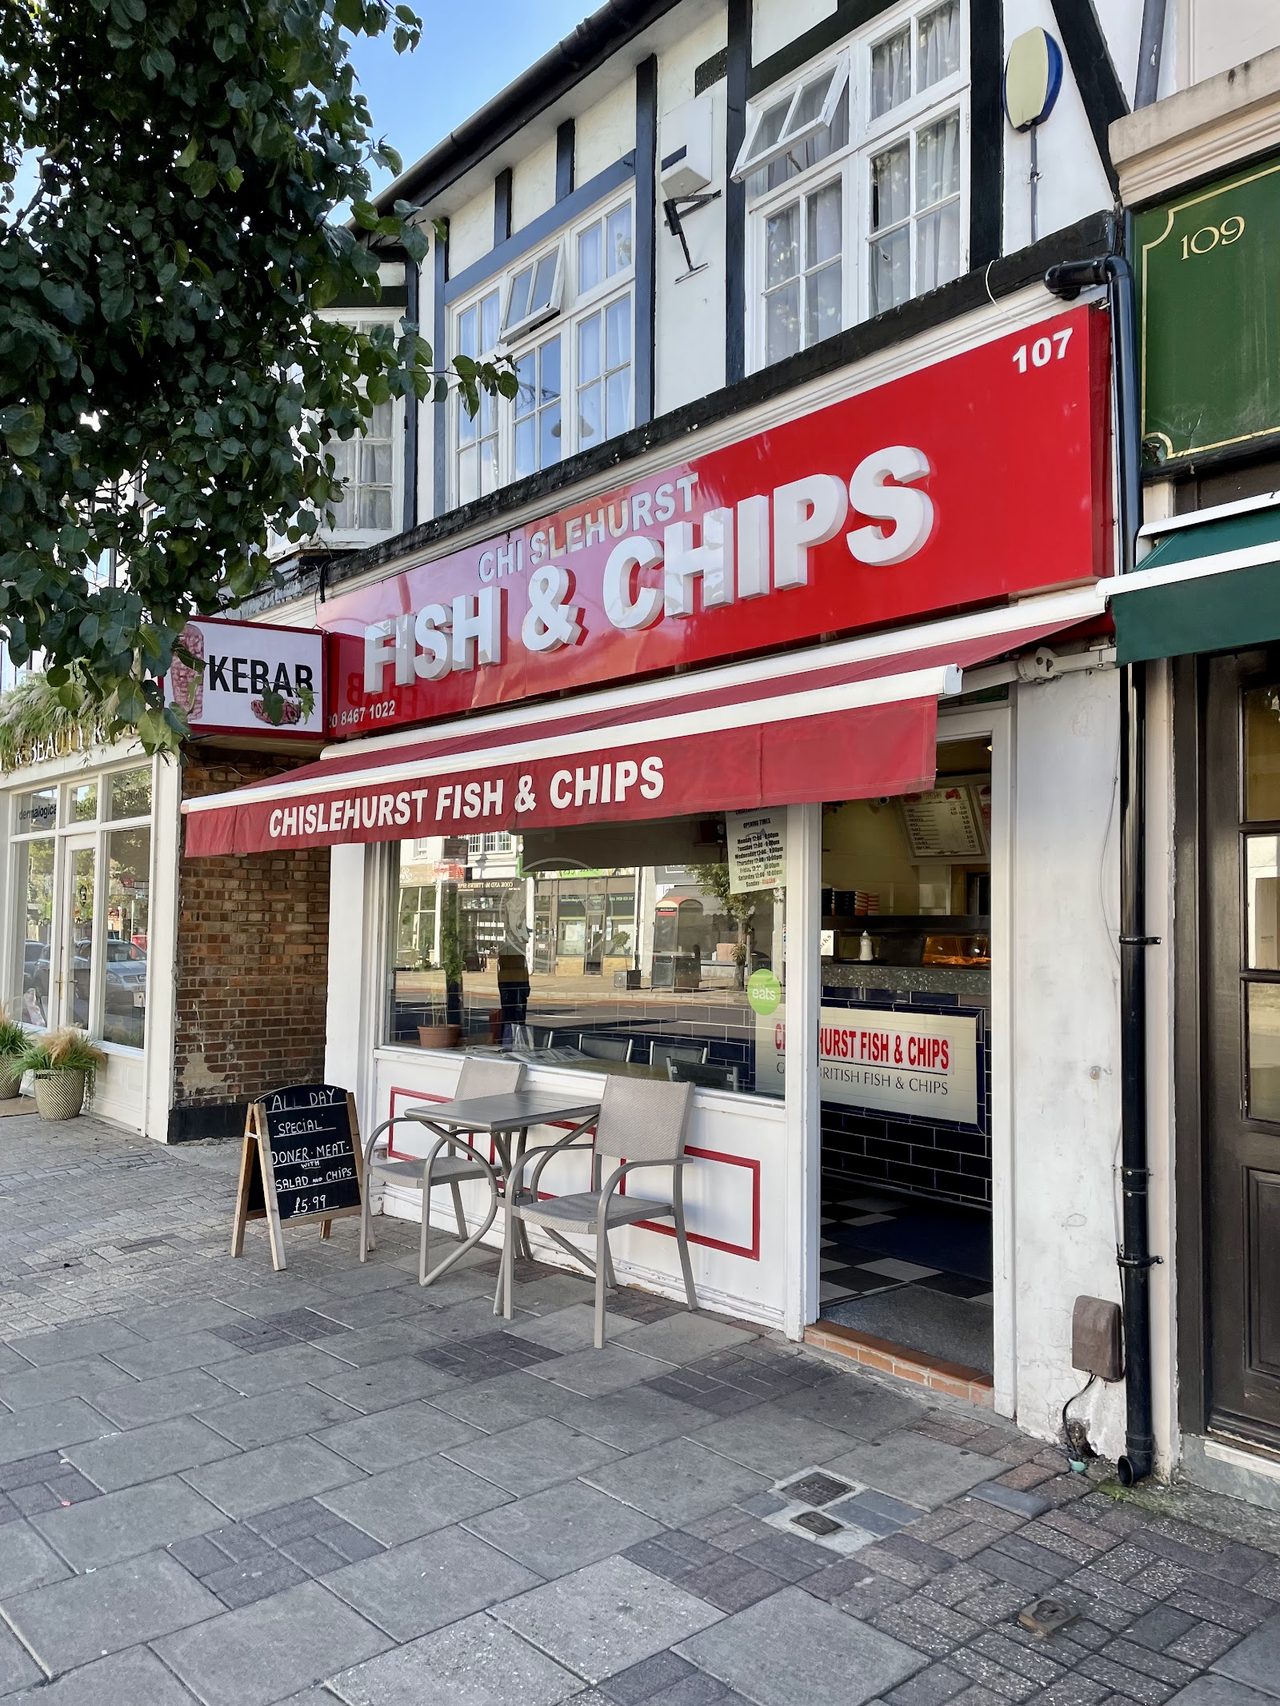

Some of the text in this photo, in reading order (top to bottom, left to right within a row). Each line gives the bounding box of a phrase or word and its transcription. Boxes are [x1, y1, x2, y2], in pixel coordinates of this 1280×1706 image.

[1181, 215, 1245, 261] 109
[1012, 327, 1074, 374] 107
[364, 445, 934, 694] FISH & CHIPS
[341, 707, 366, 726] 8467
[369, 699, 396, 720] 1022
[269, 756, 665, 838] CHISLEHURST FISH & CHIPS
[752, 988, 776, 1001] eats
[860, 1031, 889, 1062] FISH
[894, 1034, 903, 1064] &
[908, 1036, 949, 1070] CHIPS
[864, 1072, 891, 1087] FISH
[895, 1077, 905, 1090] &
[909, 1078, 948, 1095] CHIPS
[272, 1088, 335, 1112] ALL DAY
[278, 1118, 323, 1136] SPECIAL
[276, 1176, 309, 1191] SALAD
[326, 1167, 352, 1181] CHIPS
